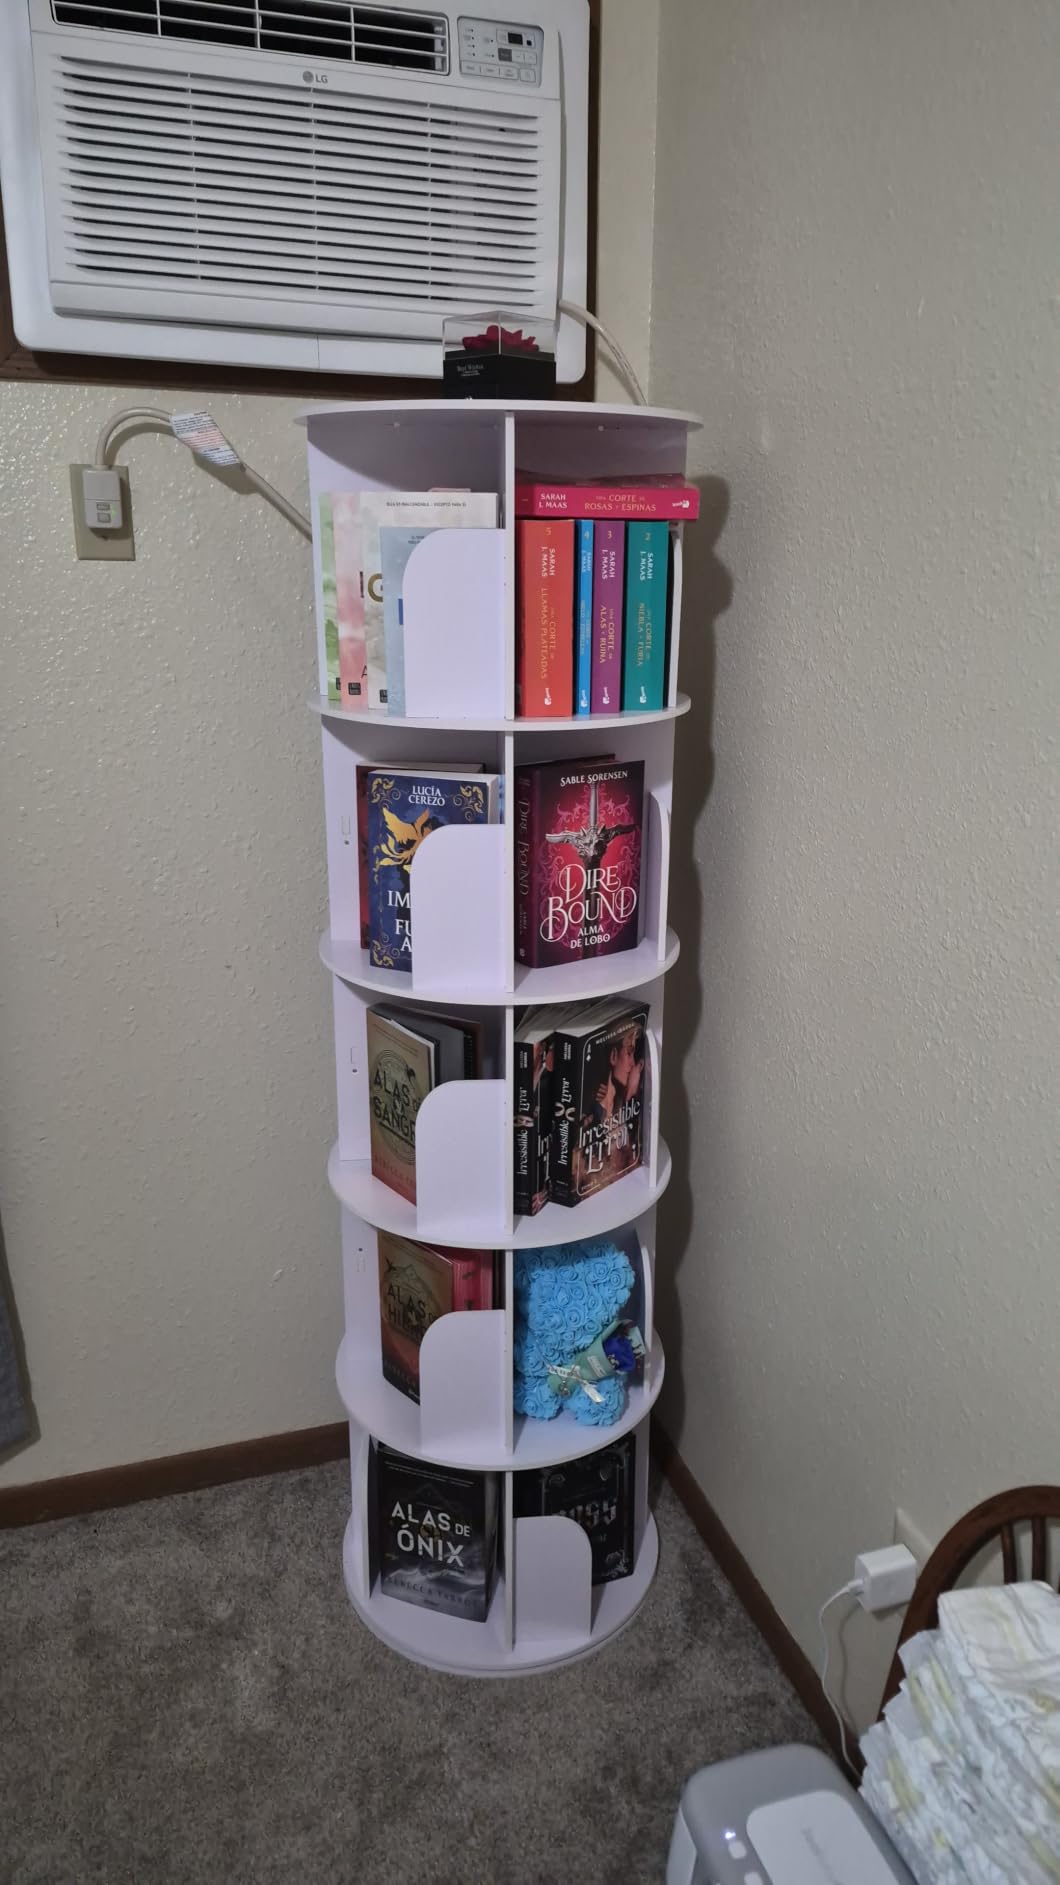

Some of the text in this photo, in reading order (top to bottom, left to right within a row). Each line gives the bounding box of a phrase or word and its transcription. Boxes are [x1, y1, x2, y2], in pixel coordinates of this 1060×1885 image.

[315, 73, 328, 84] LG
[540, 493, 566, 501] SARAH
[584, 503, 613, 511] ROSAS
[621, 503, 657, 512] ESPINAS
[608, 494, 636, 503] CORTE
[546, 527, 552, 536] 5
[607, 530, 612, 540] 3
[412, 785, 442, 797] LUCÍA
[560, 770, 628, 787] SABLE SORENSEN
[408, 795, 445, 807] CEREZO
[519, 800, 531, 834] DIRE
[518, 841, 530, 896] BOUND
[558, 863, 621, 904] DIRE
[540, 886, 637, 943] BOUND
[577, 924, 604, 937] ALMA
[570, 933, 611, 949] DE LOBO
[374, 1070, 410, 1107] ALAS
[517, 1086, 530, 1175] Irresistible Error
[558, 1077, 573, 1166] Irresistible Error
[579, 1098, 641, 1149] Irresistible
[585, 1122, 634, 1175] Error
[387, 1284, 426, 1319] ALAS
[391, 1501, 471, 1537] ALAS DE
[397, 1523, 464, 1567] ÓNIX
